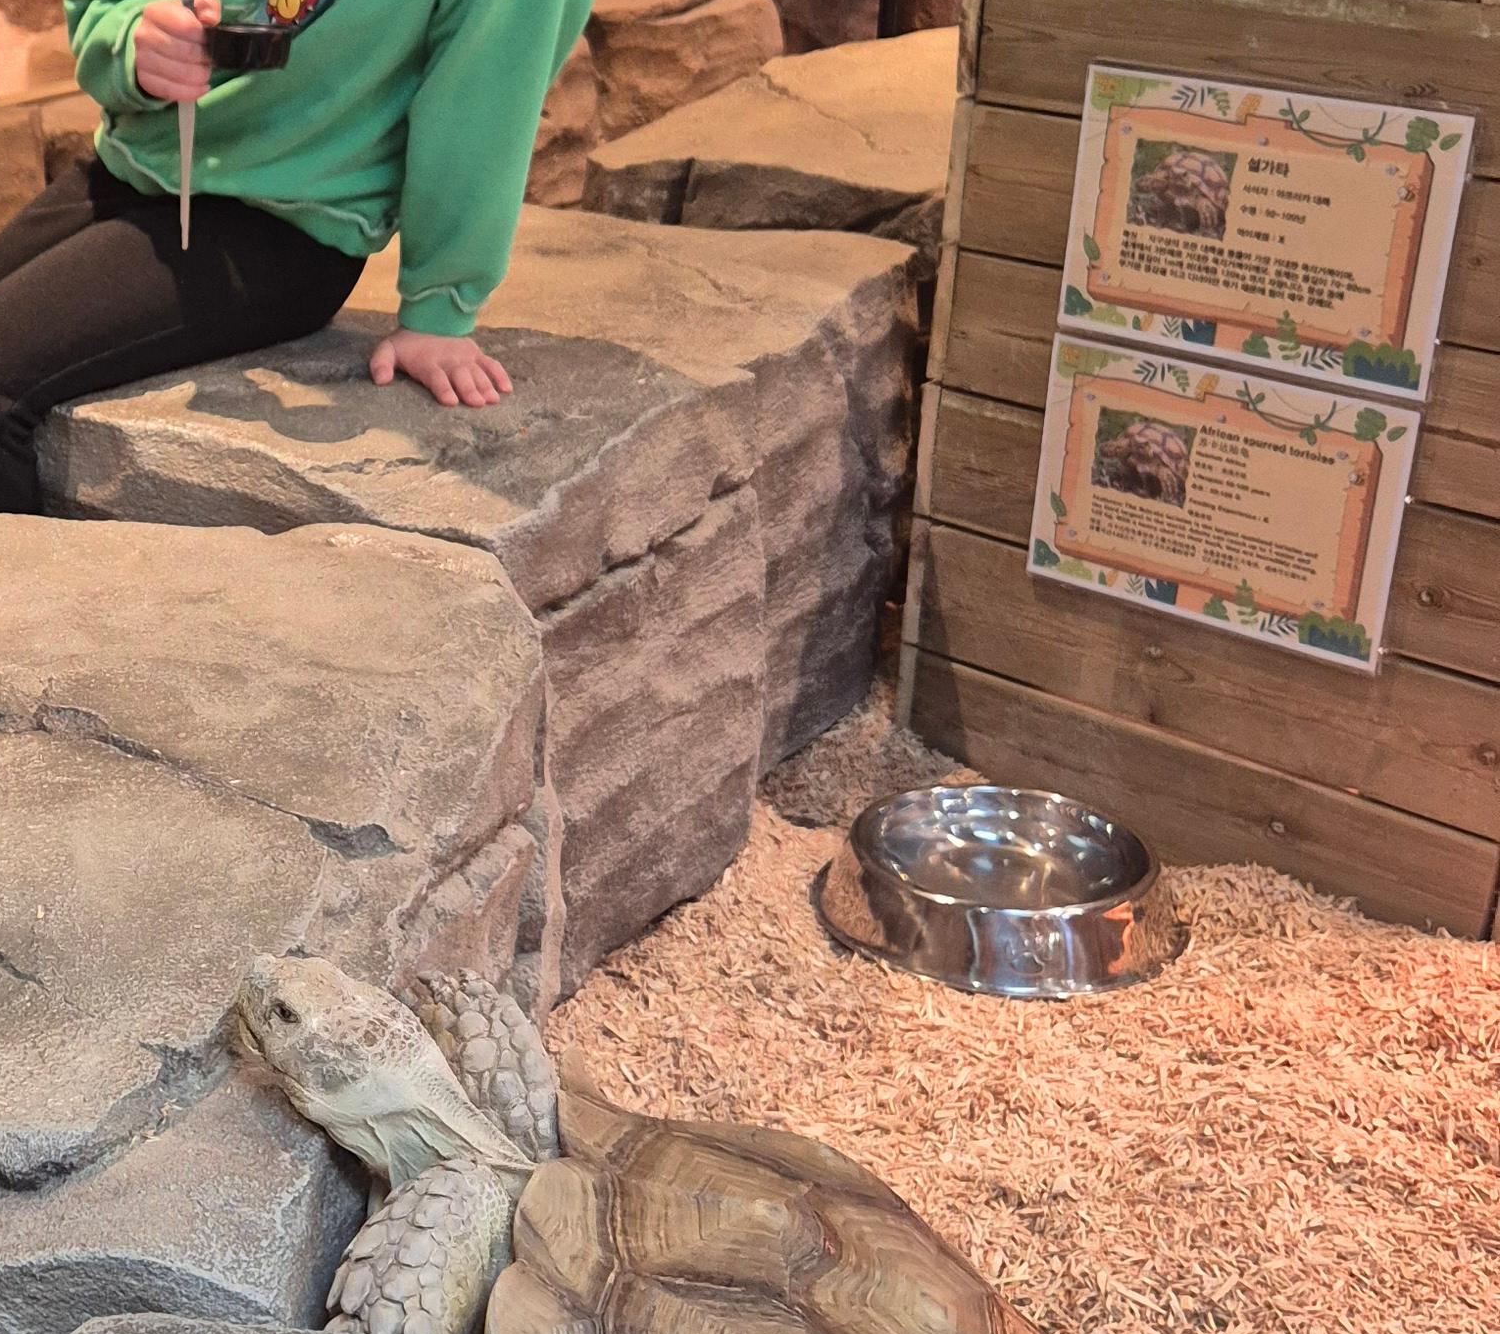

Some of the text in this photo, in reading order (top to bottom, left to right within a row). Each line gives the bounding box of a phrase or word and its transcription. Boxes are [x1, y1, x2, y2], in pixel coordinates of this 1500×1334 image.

[1247, 157, 1290, 177] 설가타
[1275, 189, 1310, 203] 아프리카
[1199, 424, 1335, 465] African spurred tortoise
